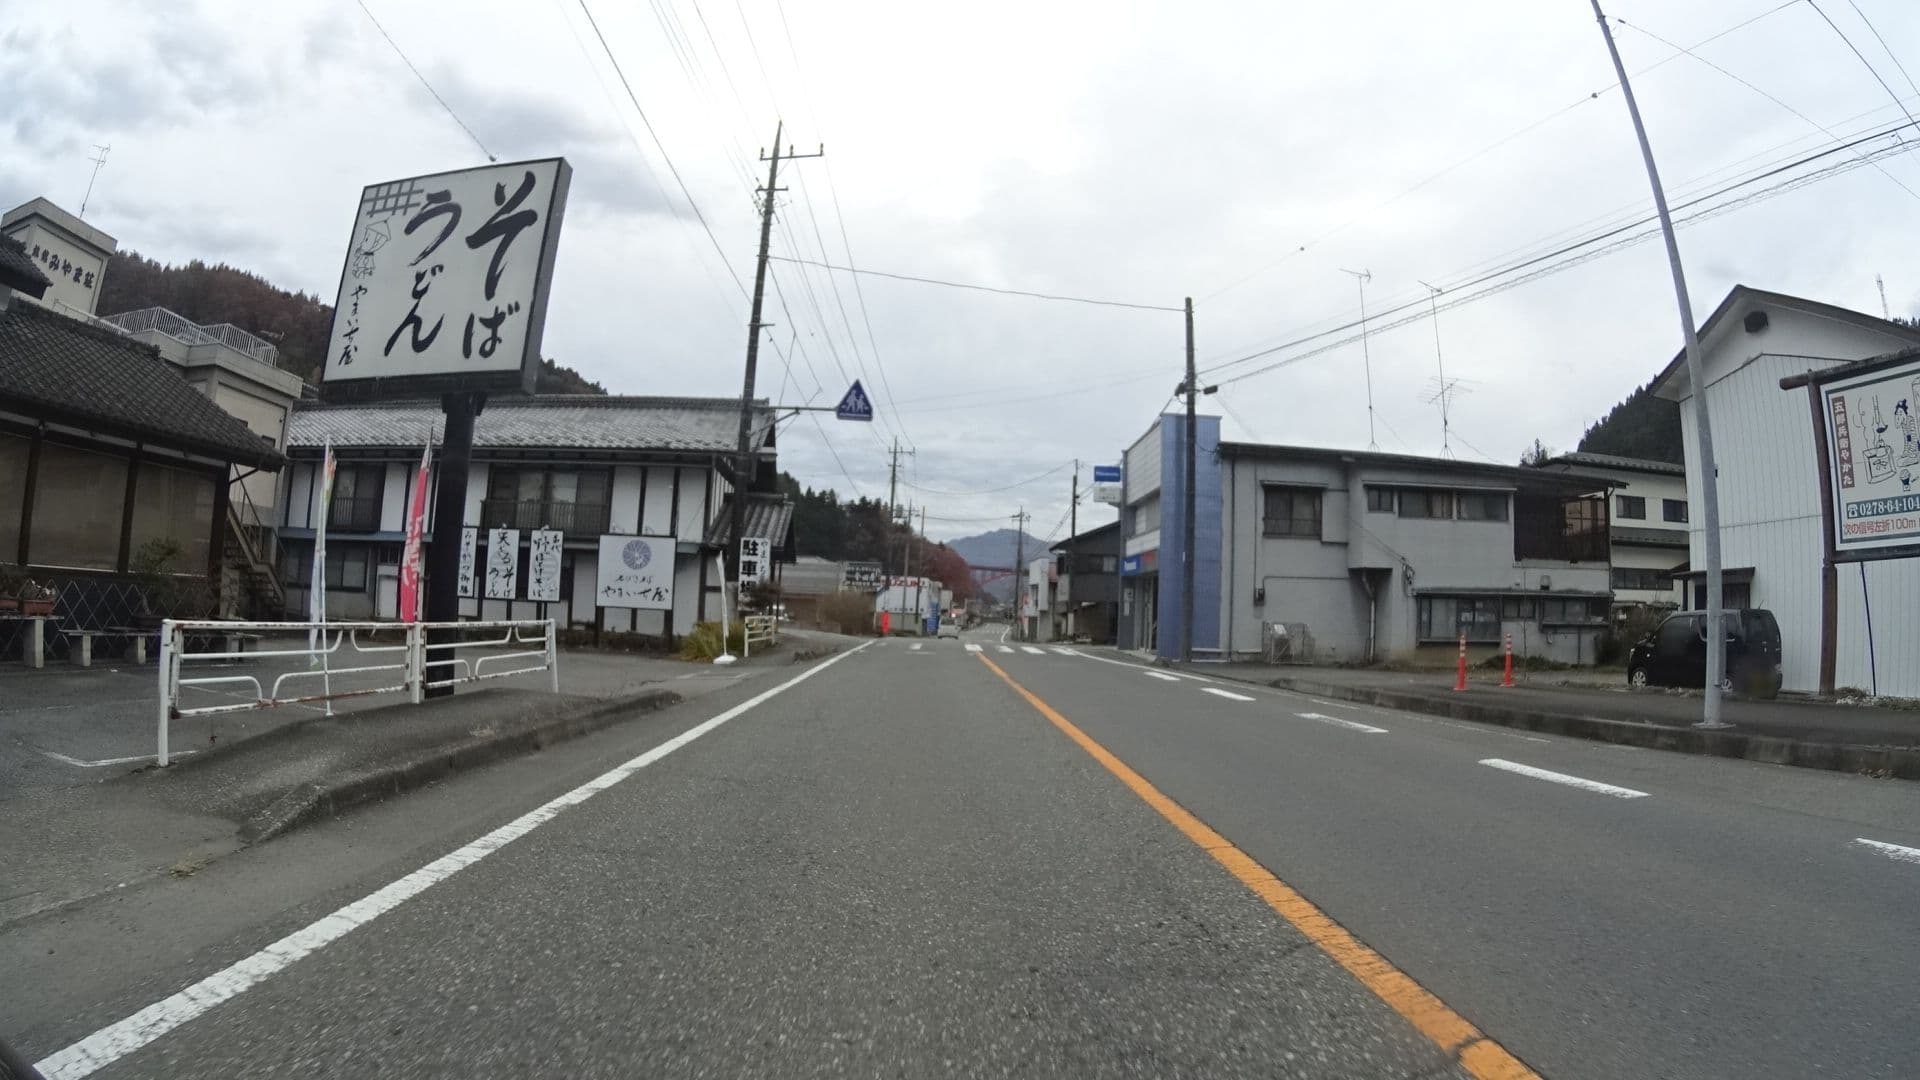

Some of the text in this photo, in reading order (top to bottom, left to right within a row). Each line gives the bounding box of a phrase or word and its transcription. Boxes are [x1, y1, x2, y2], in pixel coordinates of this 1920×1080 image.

[384, 188, 462, 357] うどん
[465, 170, 539, 359] そば
